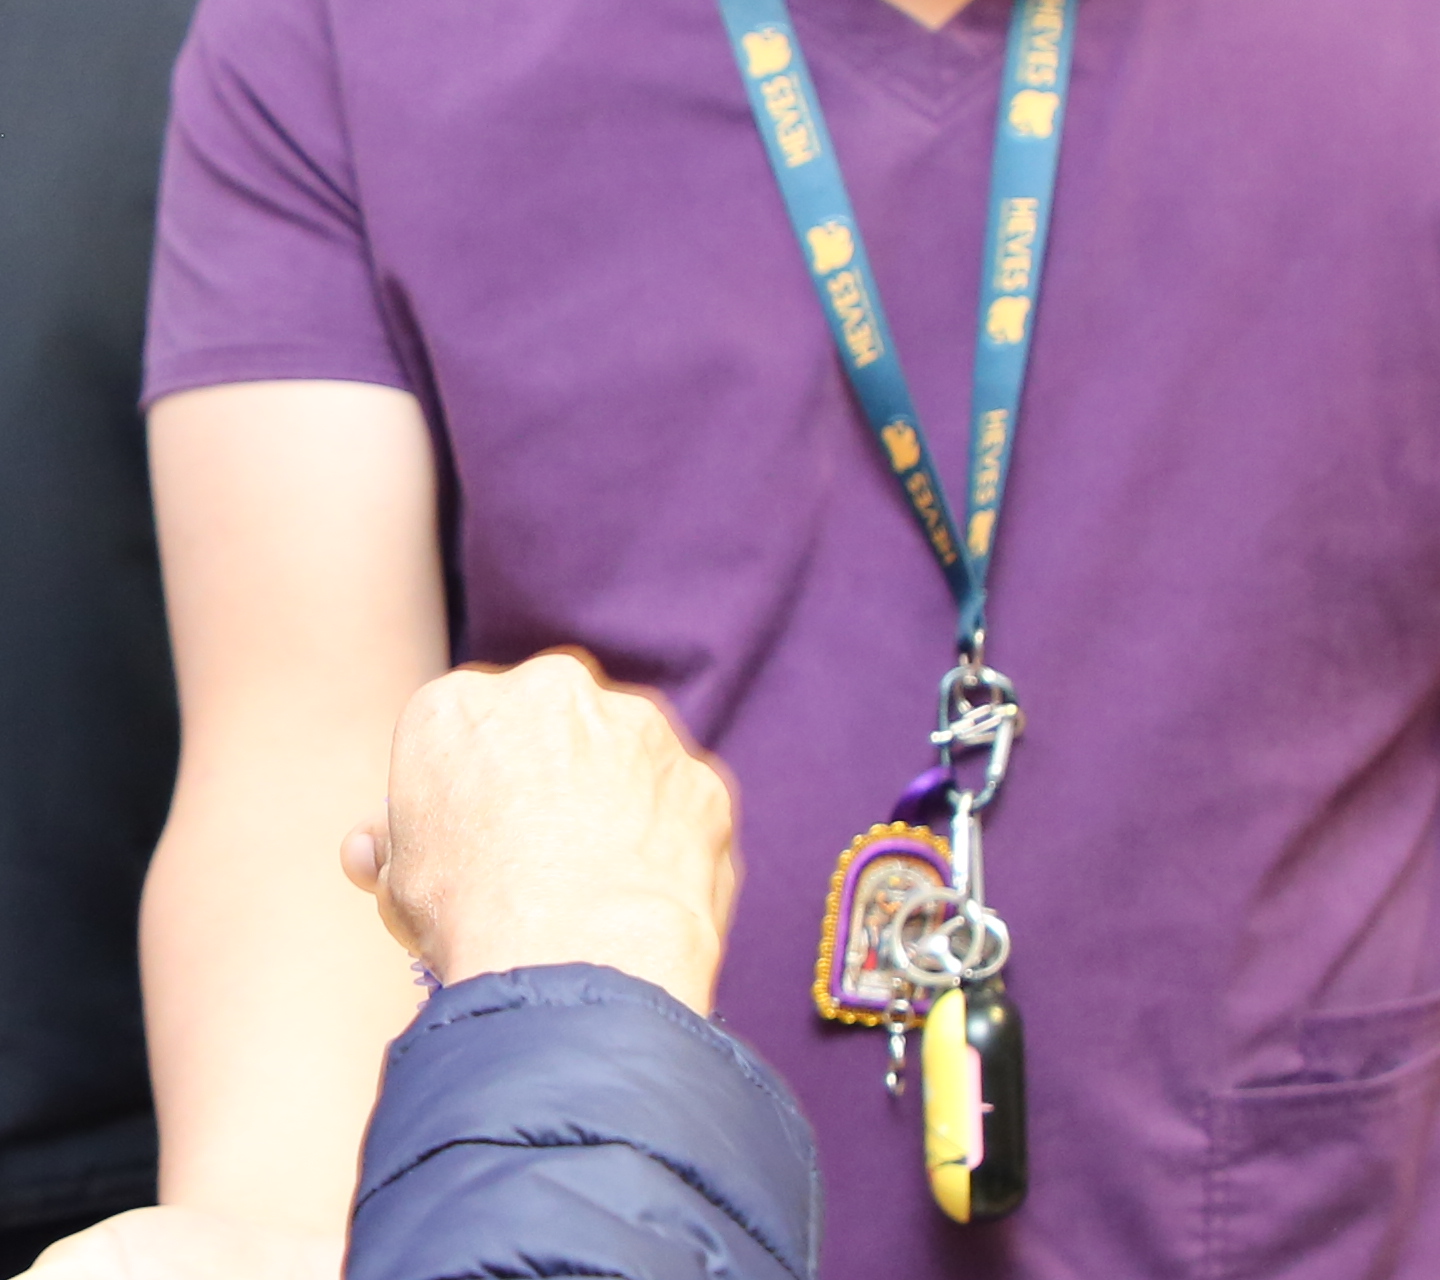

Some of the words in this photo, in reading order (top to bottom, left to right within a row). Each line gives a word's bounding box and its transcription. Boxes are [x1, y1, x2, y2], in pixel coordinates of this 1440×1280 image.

[760, 73, 815, 169] HEVES
[995, 195, 1039, 291] HEVES
[825, 268, 880, 369] HEVES
[973, 409, 1010, 505] HEVES
